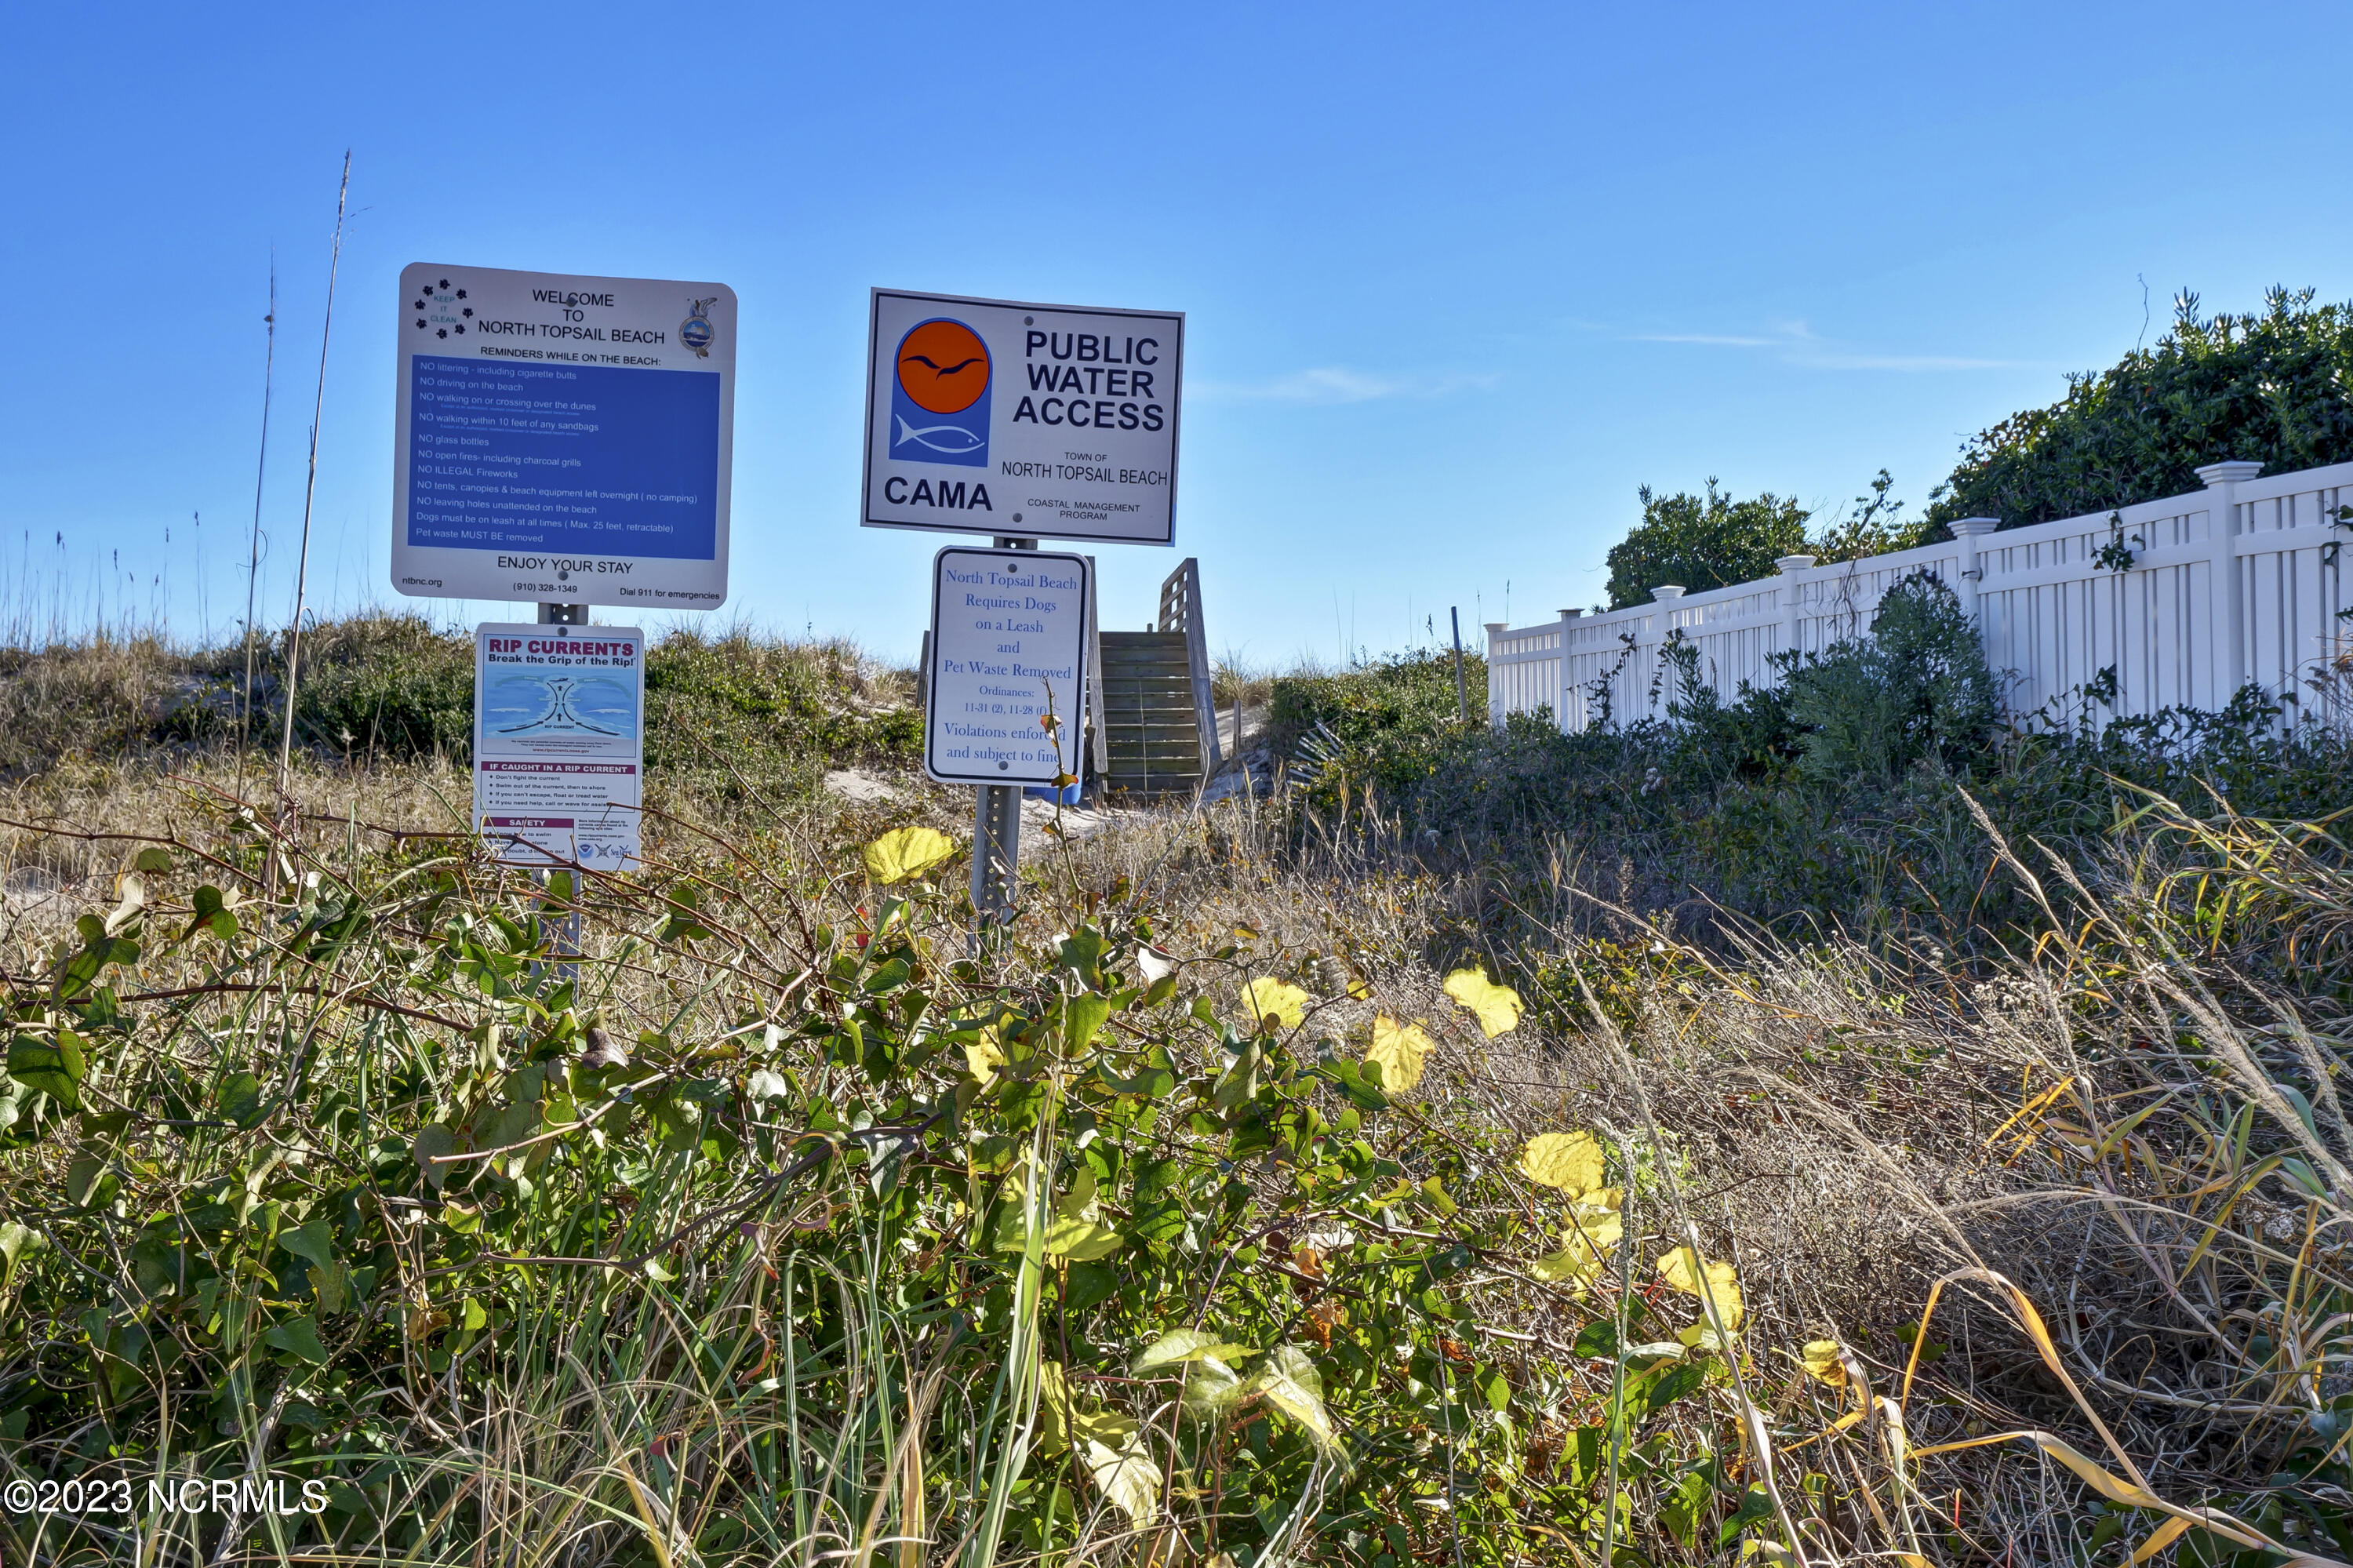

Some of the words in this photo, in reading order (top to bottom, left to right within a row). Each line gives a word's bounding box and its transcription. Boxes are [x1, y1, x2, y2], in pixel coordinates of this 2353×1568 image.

[533, 289, 614, 306] WELCOME
[563, 309, 583, 322] TO
[479, 320, 534, 335] NORTH
[540, 324, 606, 340] TOPSAIL
[611, 329, 664, 343] BEACH
[480, 346, 543, 359] REMINDERS
[546, 351, 578, 361] WHILE
[581, 353, 596, 362] ON
[600, 354, 619, 363] THE
[623, 355, 660, 365] BEACH:
[1026, 330, 1158, 365] PUBLIC
[420, 362, 435, 370] NO
[437, 362, 468, 375] littering
[477, 366, 515, 378] including
[517, 370, 553, 379] cigarette
[556, 370, 576, 380] butts
[420, 376, 434, 386] NO
[437, 378, 465, 389] driving
[481, 381, 494, 390] the
[497, 382, 523, 391] beach
[1027, 363, 1154, 398] WATER
[420, 392, 434, 401] NO
[436, 394, 468, 406] walking
[496, 398, 531, 409] crossing
[555, 401, 568, 409] the
[570, 401, 596, 411] dunes
[1013, 396, 1163, 431] ACCESS
[419, 412, 433, 421] NO
[436, 414, 468, 426] walking
[471, 416, 495, 427] within
[499, 417, 508, 426] 10
[511, 418, 527, 427] feet
[540, 421, 555, 430] any
[558, 422, 598, 433] sandbags
[418, 433, 433, 442] NO
[435, 435, 458, 445] glass
[461, 436, 489, 446] bottles
[418, 449, 432, 458] NO
[435, 452, 456, 460] open
[483, 454, 521, 465] including
[523, 456, 559, 465] charcoal
[561, 458, 581, 468] grills
[1064, 451, 1092, 461] TOWN
[1094, 453, 1107, 462] OF
[418, 464, 432, 473] NO
[435, 465, 473, 476] ILLEGAL
[476, 467, 518, 478] Fireworks
[1002, 461, 1051, 478] NORTH
[1056, 465, 1114, 482] TOPSAIL
[1120, 469, 1168, 486] BEACH
[417, 480, 431, 489] NO
[460, 484, 499, 493] canopies
[501, 485, 507, 493] &
[510, 485, 536, 495] beach
[538, 489, 582, 497] equipment
[585, 489, 597, 498] left
[599, 491, 638, 501] overnight
[659, 494, 697, 504] camping)
[885, 476, 992, 510] CAMA
[417, 496, 431, 505] NO
[434, 497, 464, 509] leaving
[467, 499, 490, 508] holes
[492, 501, 540, 511] unattended
[555, 503, 569, 512] the
[571, 504, 596, 514] beach
[1028, 498, 1070, 509] COASTAL
[1074, 501, 1140, 512] MANAGEMENT
[416, 511, 439, 522] Dogs
[442, 514, 462, 522] must
[465, 514, 476, 523] be
[492, 515, 514, 525] leash
[527, 518, 536, 526] all
[539, 518, 562, 527] times
[593, 521, 603, 529] 25
[626, 523, 673, 534] retractable)
[1060, 510, 1107, 520] PROGRAM
[416, 527, 430, 537] Pet
[433, 530, 458, 539] waste
[461, 530, 487, 539] MUST
[491, 531, 503, 540] BE
[506, 534, 543, 542] removed
[498, 556, 547, 569] ENJOY
[551, 559, 592, 573] YOUR
[597, 561, 633, 574] STAY
[402, 576, 442, 588] ntbnc.org
[513, 582, 536, 593] (910)
[538, 583, 577, 593] 328-1349
[946, 570, 982, 583] North
[988, 572, 1034, 588] Topsail
[1039, 575, 1076, 589] Beach
[620, 587, 635, 596] Dial
[638, 588, 651, 596] 911
[655, 589, 666, 597] for
[668, 591, 719, 600] emergencies
[966, 593, 1019, 609] Requires
[1025, 597, 1055, 613] Dogs
[976, 620, 991, 629] on
[995, 621, 1002, 630] a
[1007, 619, 1042, 632] Leash
[490, 639, 521, 652] RIP
[528, 640, 633, 656] CURRENTS
[997, 640, 1019, 653] and
[489, 654, 522, 662] Break
[526, 655, 544, 663] the
[548, 655, 572, 666] Grip
[591, 657, 608, 665] the
[944, 660, 963, 672] Pet
[969, 661, 1007, 675] Waste
[1013, 664, 1070, 679] Removed
[979, 685, 1034, 697] Ordinances:
[965, 702, 987, 712] 11-31
[991, 704, 1005, 715] (2),
[1010, 704, 1033, 715] 11-28
[944, 723, 1006, 737] Violations
[1011, 727, 1066, 741] enforcd
[947, 745, 969, 758] and
[974, 746, 1016, 762] subject
[1021, 751, 1033, 760] to
